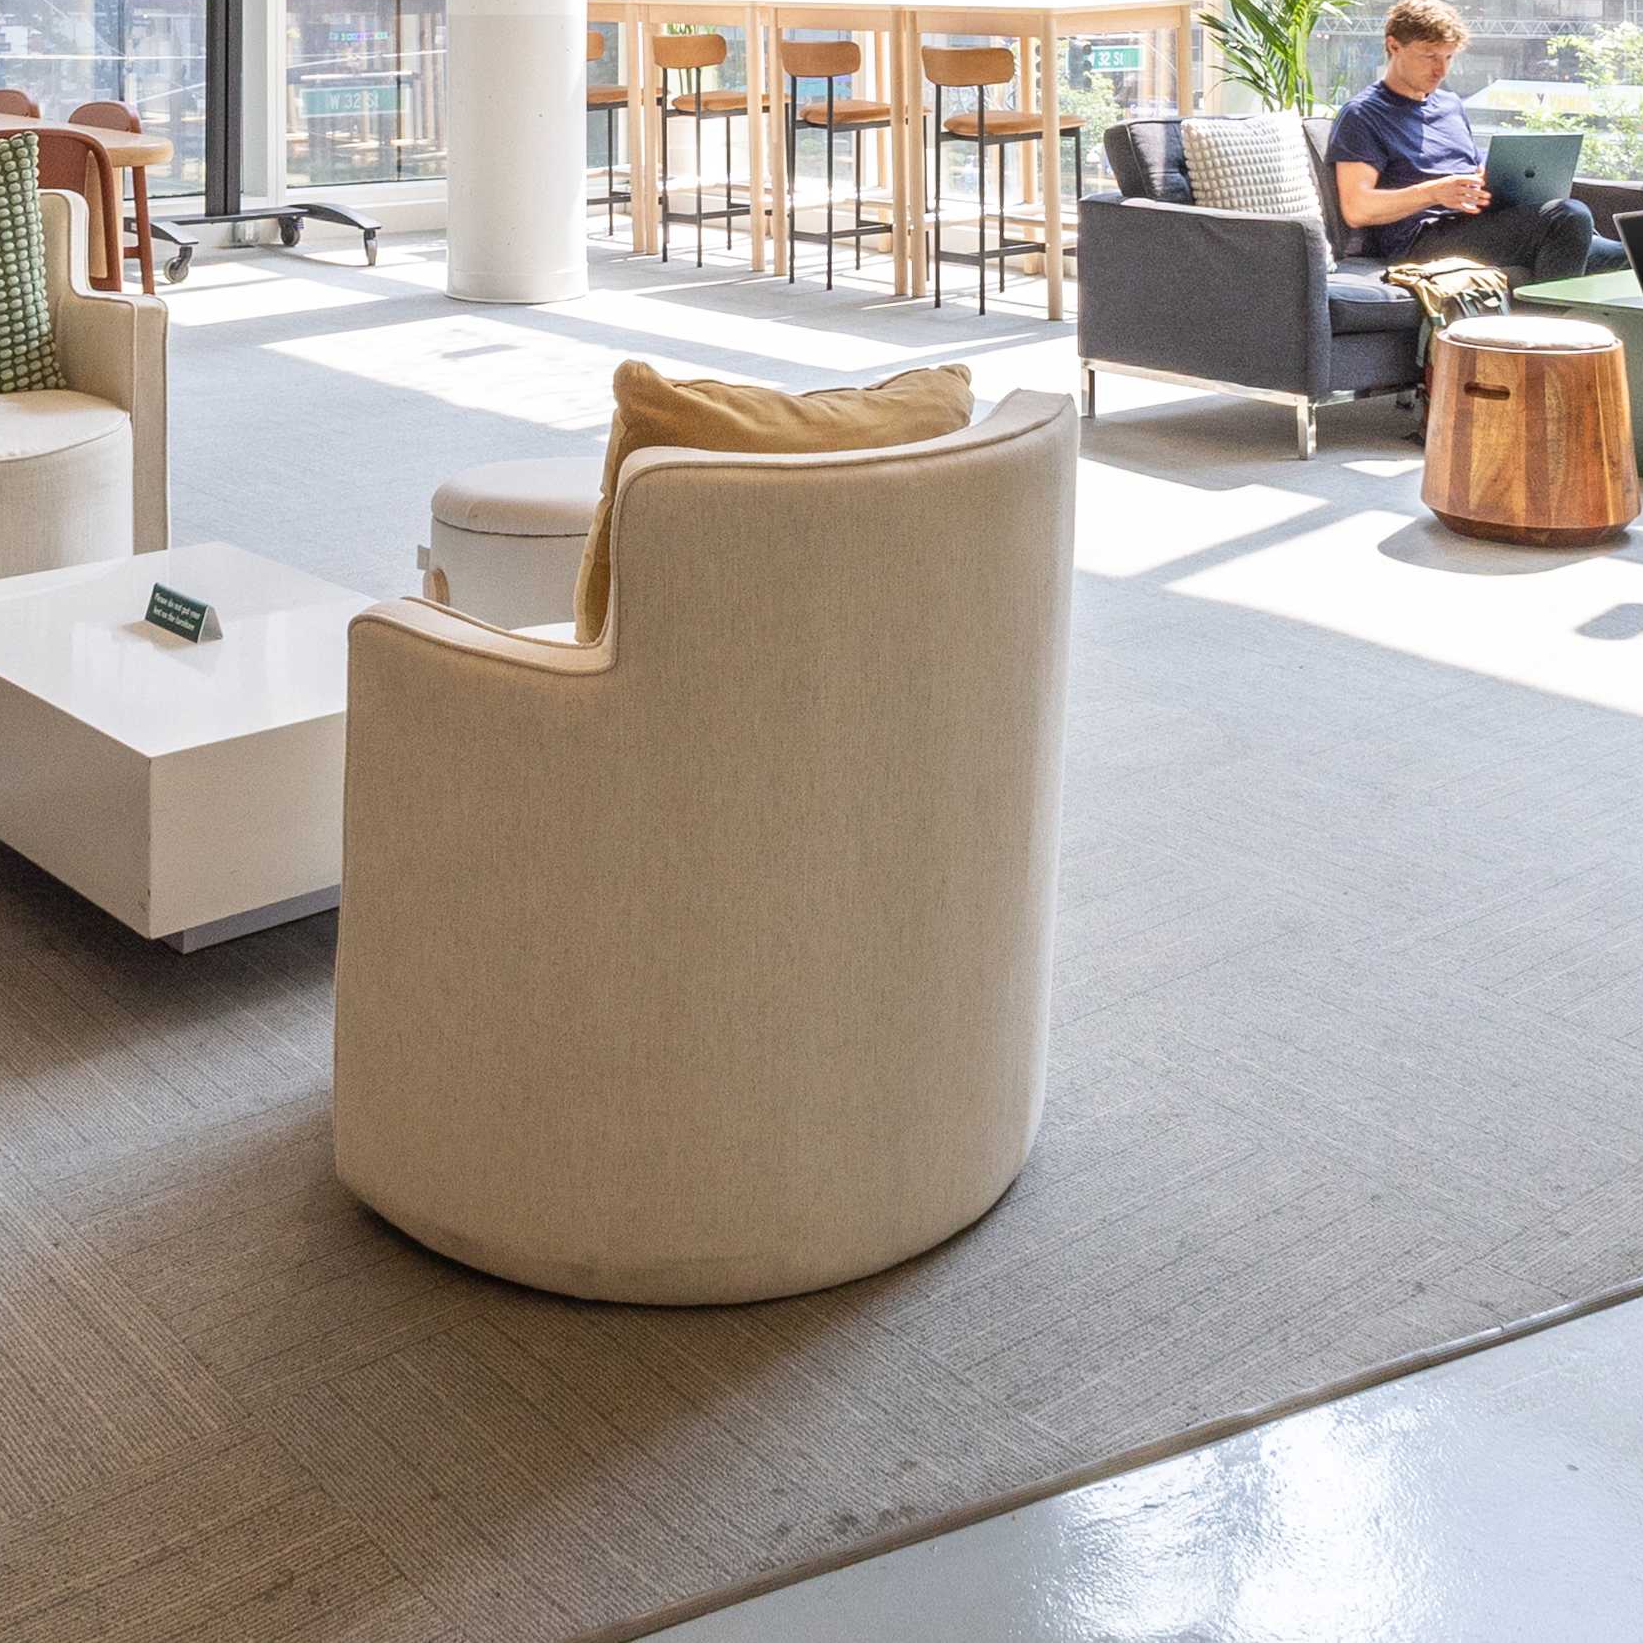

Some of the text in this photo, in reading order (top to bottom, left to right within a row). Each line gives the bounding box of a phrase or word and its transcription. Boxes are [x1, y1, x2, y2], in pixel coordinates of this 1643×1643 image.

[1098, 51, 1111, 66] 32
[1113, 51, 1125, 65] St
[328, 94, 341, 110] W
[344, 93, 361, 109] 32
